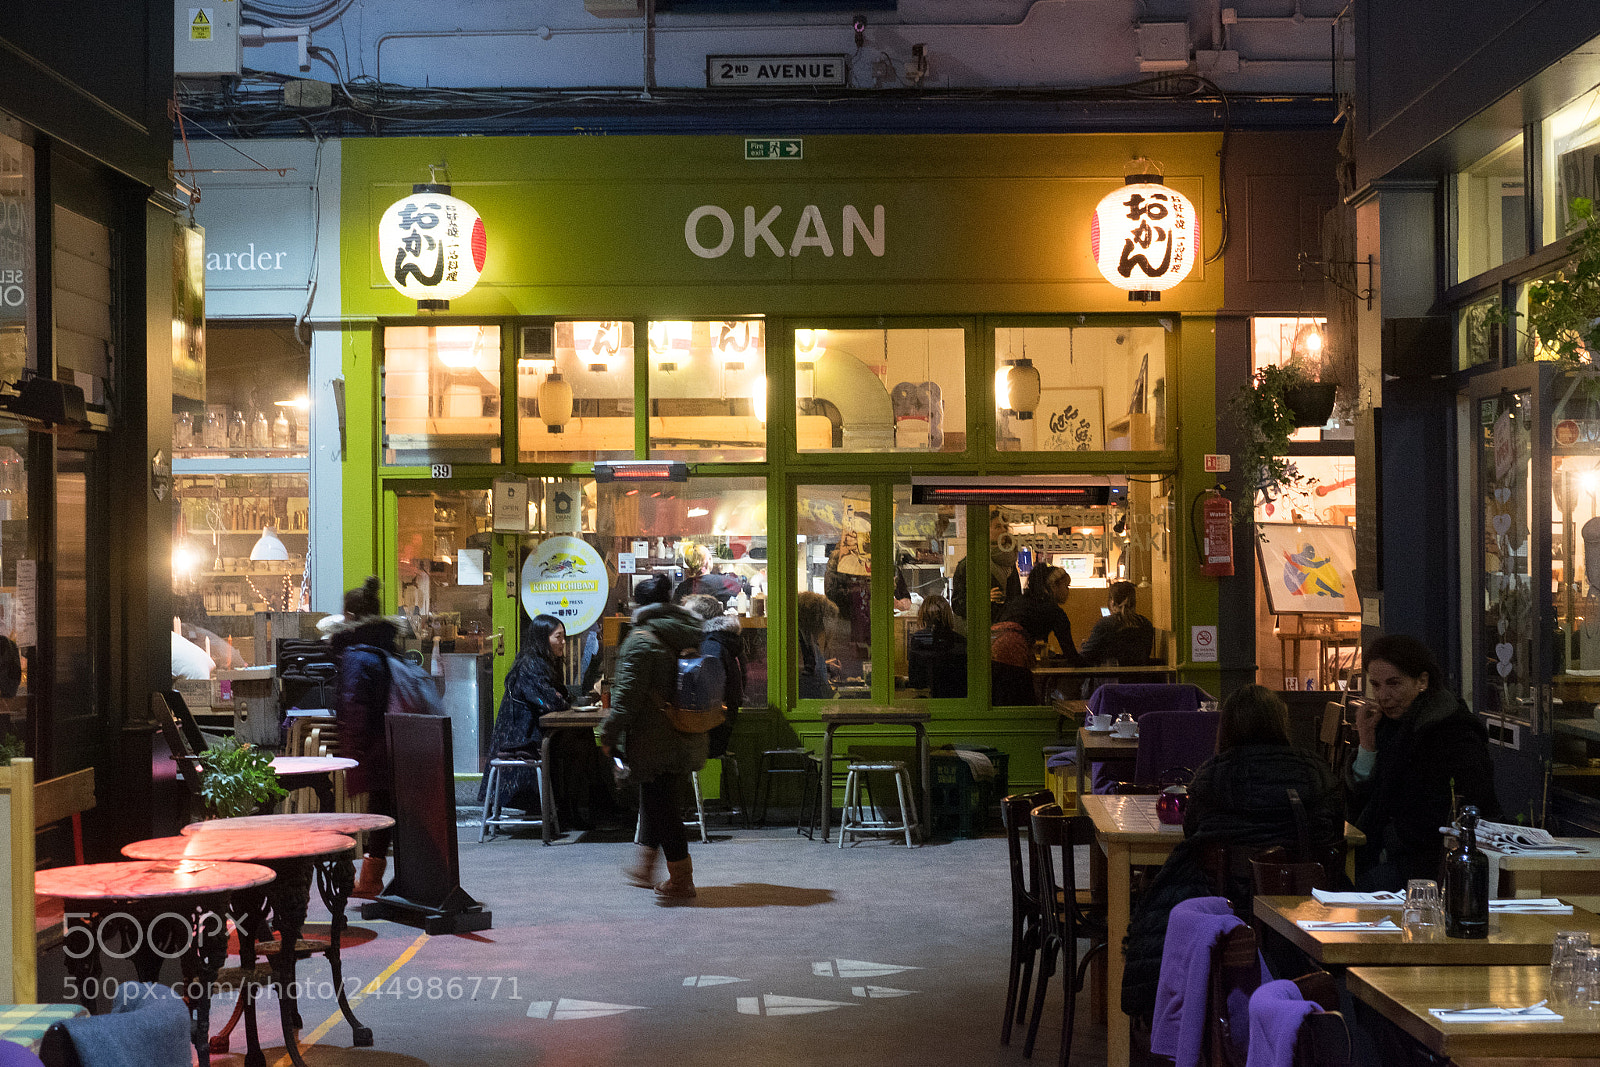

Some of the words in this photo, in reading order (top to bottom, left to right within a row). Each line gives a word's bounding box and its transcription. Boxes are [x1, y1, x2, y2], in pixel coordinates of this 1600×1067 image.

[720, 63, 749, 78] 2ND
[757, 64, 835, 78] AVENUE
[394, 202, 444, 287] おかん
[684, 204, 886, 259] OKAN
[1117, 193, 1173, 278] おかん
[206, 242, 288, 271] arder
[433, 464, 450, 478] 39
[533, 582, 558, 591] KIRIN
[560, 581, 595, 591] ICHIBAN
